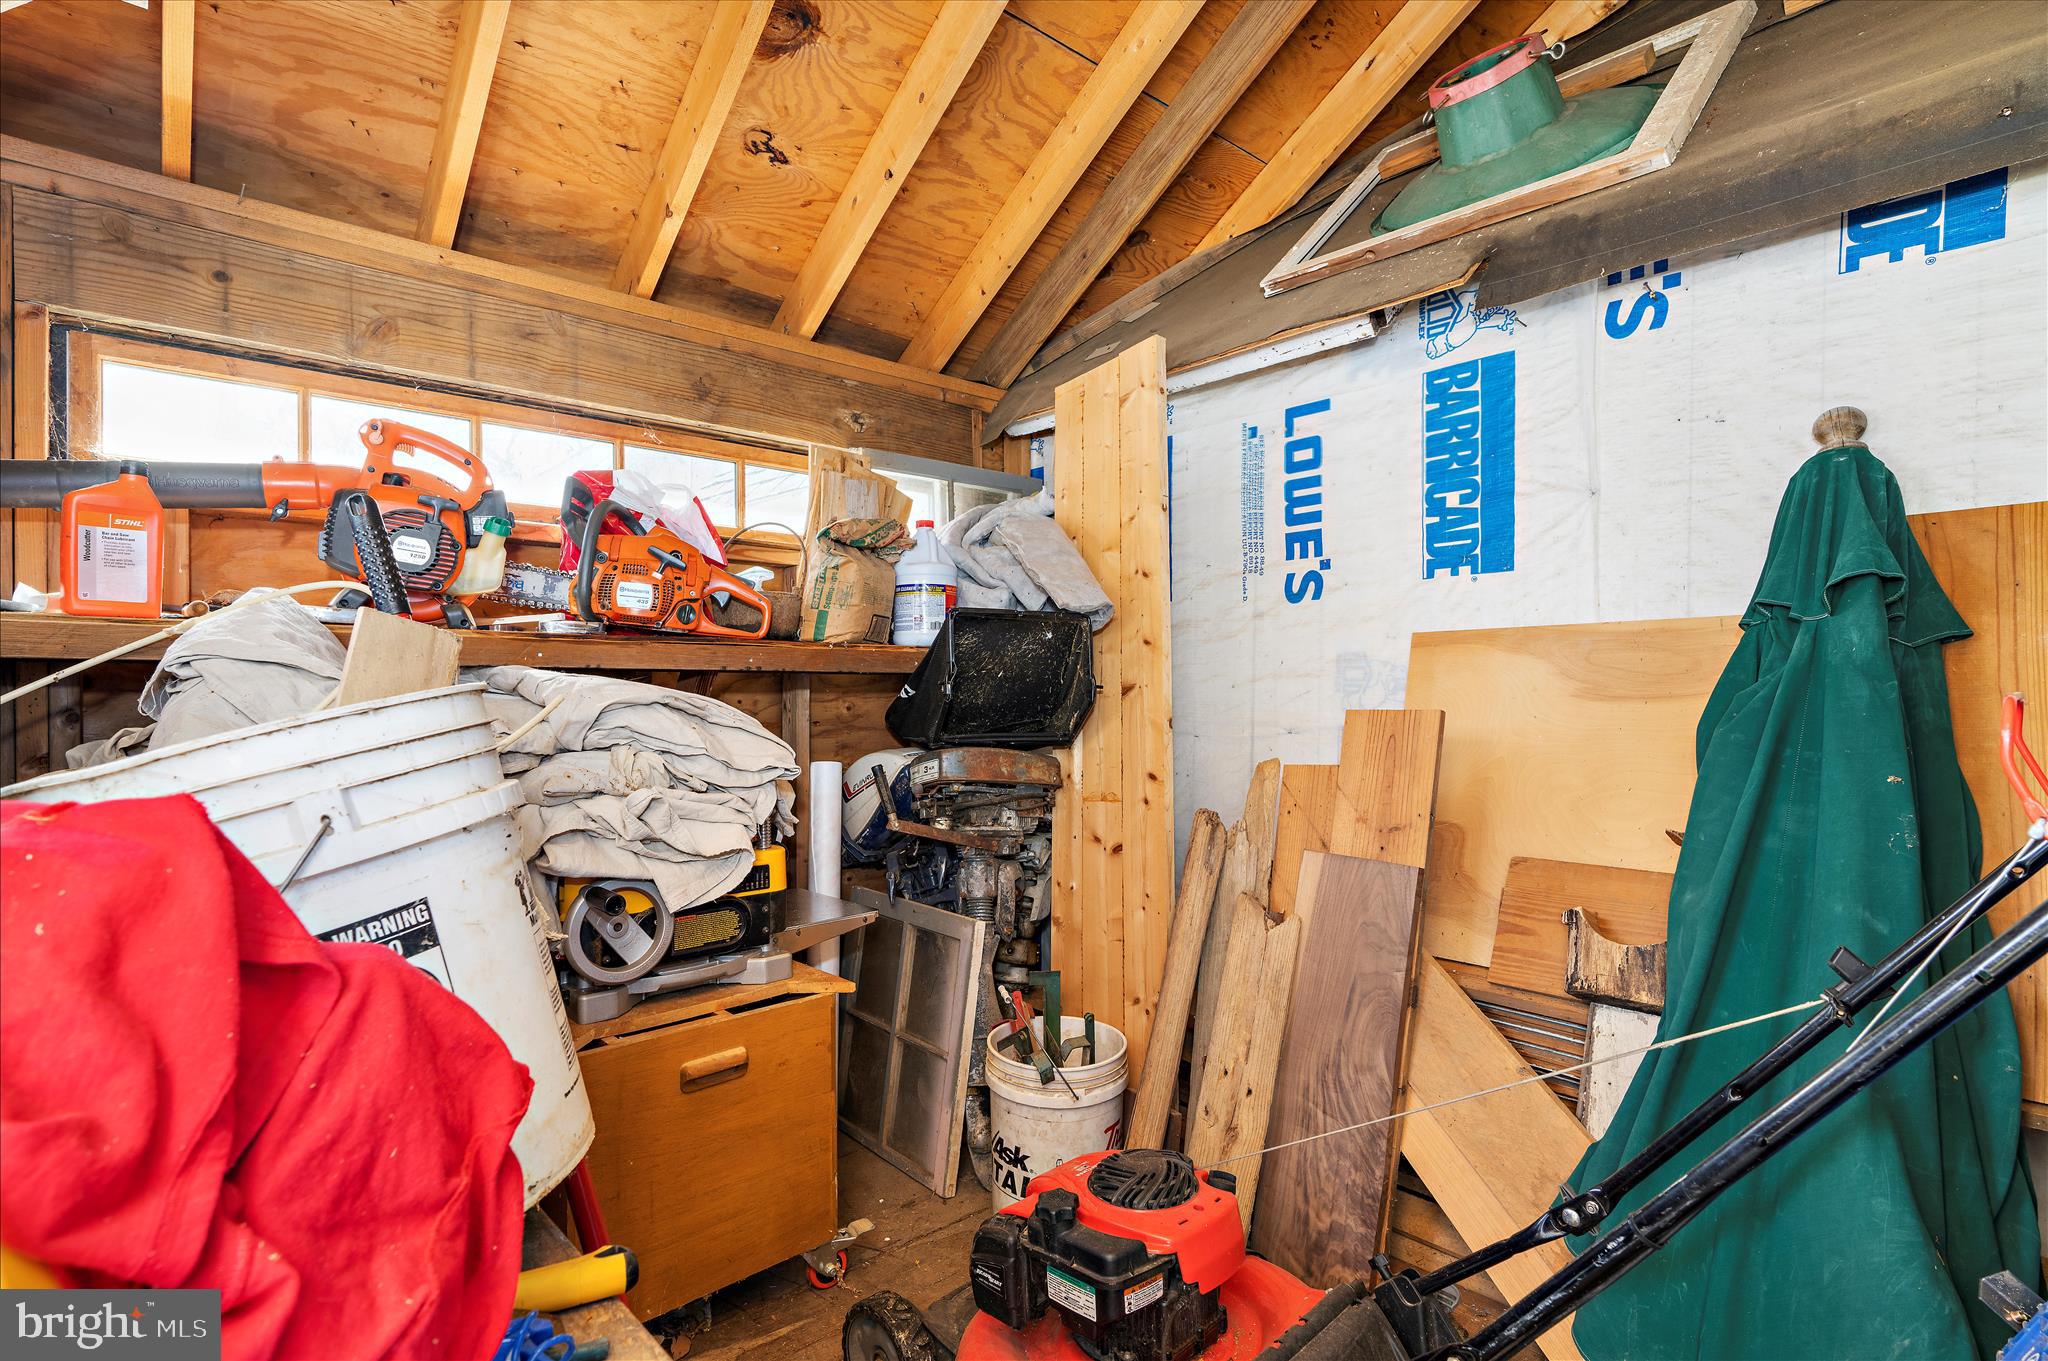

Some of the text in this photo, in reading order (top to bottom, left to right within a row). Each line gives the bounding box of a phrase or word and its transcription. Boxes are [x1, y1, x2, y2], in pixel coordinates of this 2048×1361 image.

[155, 475, 240, 489] Husqvarna
[1423, 358, 1481, 580] BARRICADE
[1284, 398, 1331, 605] LOWE'S
[114, 518, 144, 527] STIHL
[83, 529, 91, 561] Woodcutter
[331, 903, 431, 943] WARNING
[993, 1136, 1031, 1173] Ask
